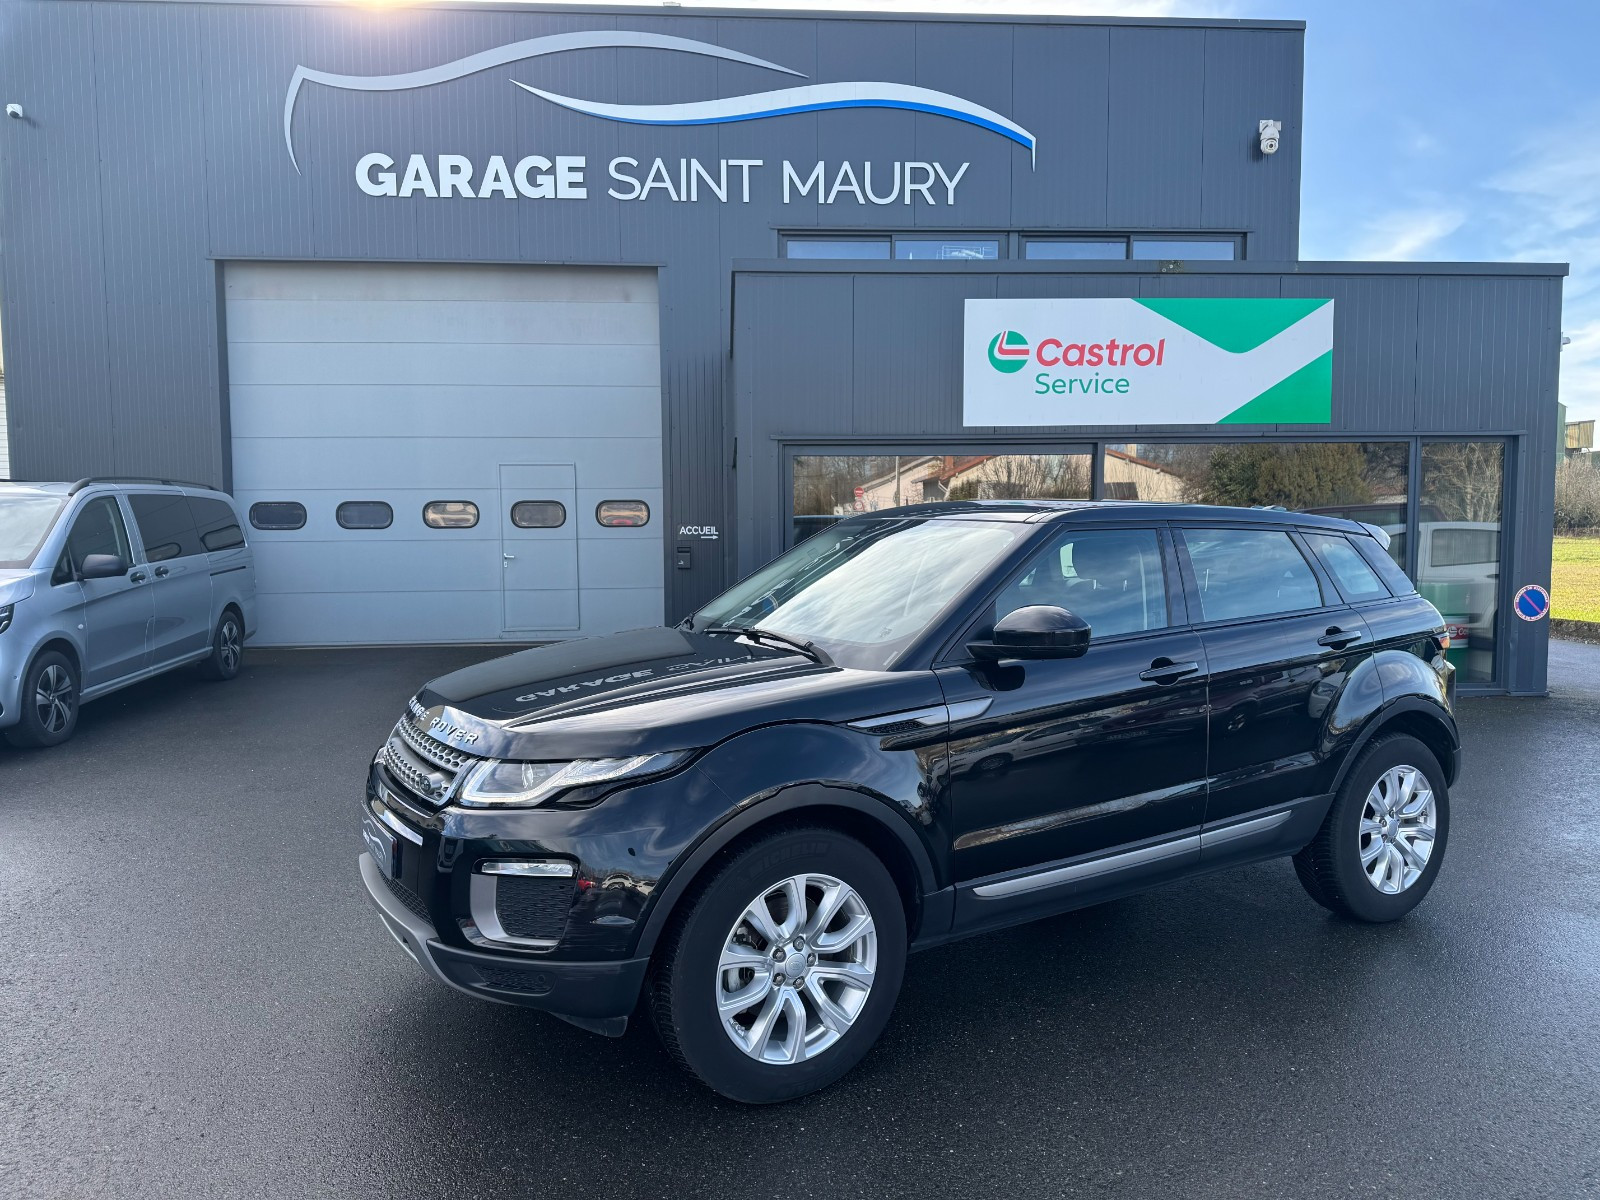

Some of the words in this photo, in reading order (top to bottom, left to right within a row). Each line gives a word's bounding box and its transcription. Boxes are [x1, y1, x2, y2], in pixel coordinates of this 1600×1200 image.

[355, 153, 588, 200] GARAGE
[607, 156, 763, 204] SAINT
[782, 160, 970, 207] MAURY
[1036, 338, 1166, 367] Castrol
[1035, 372, 1130, 395] Service
[679, 526, 719, 535] ACCUEIL
[430, 716, 479, 746] ROVER
[749, 842, 829, 878] ICHELIN
